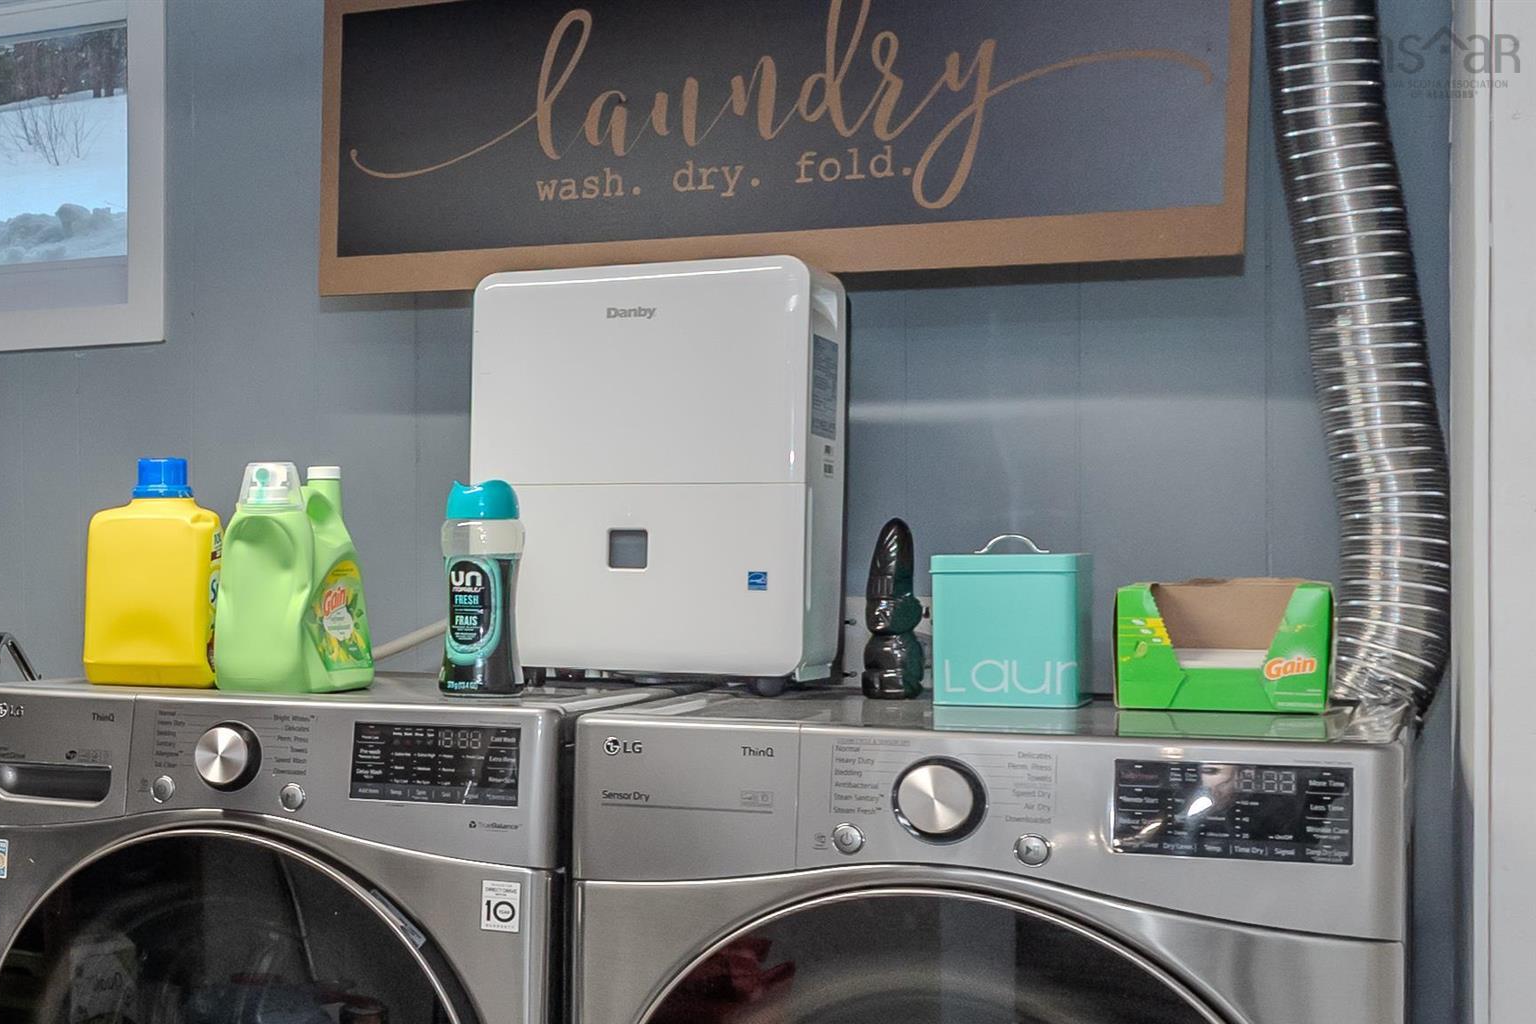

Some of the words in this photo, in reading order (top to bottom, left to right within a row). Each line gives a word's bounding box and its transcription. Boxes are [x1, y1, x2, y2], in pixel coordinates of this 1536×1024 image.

[535, 167, 642, 201] wash.
[672, 160, 761, 198] dry.
[795, 145, 913, 184] fold.
[606, 306, 657, 320] Danby
[322, 585, 347, 618] Gain
[454, 594, 479, 605] FRESH
[454, 615, 478, 626] FRAIS
[1264, 656, 1318, 681] Gain
[91, 712, 116, 722] ThinQ
[622, 741, 643, 754] LG
[741, 746, 775, 757] ThinQ
[485, 899, 516, 923] 10
